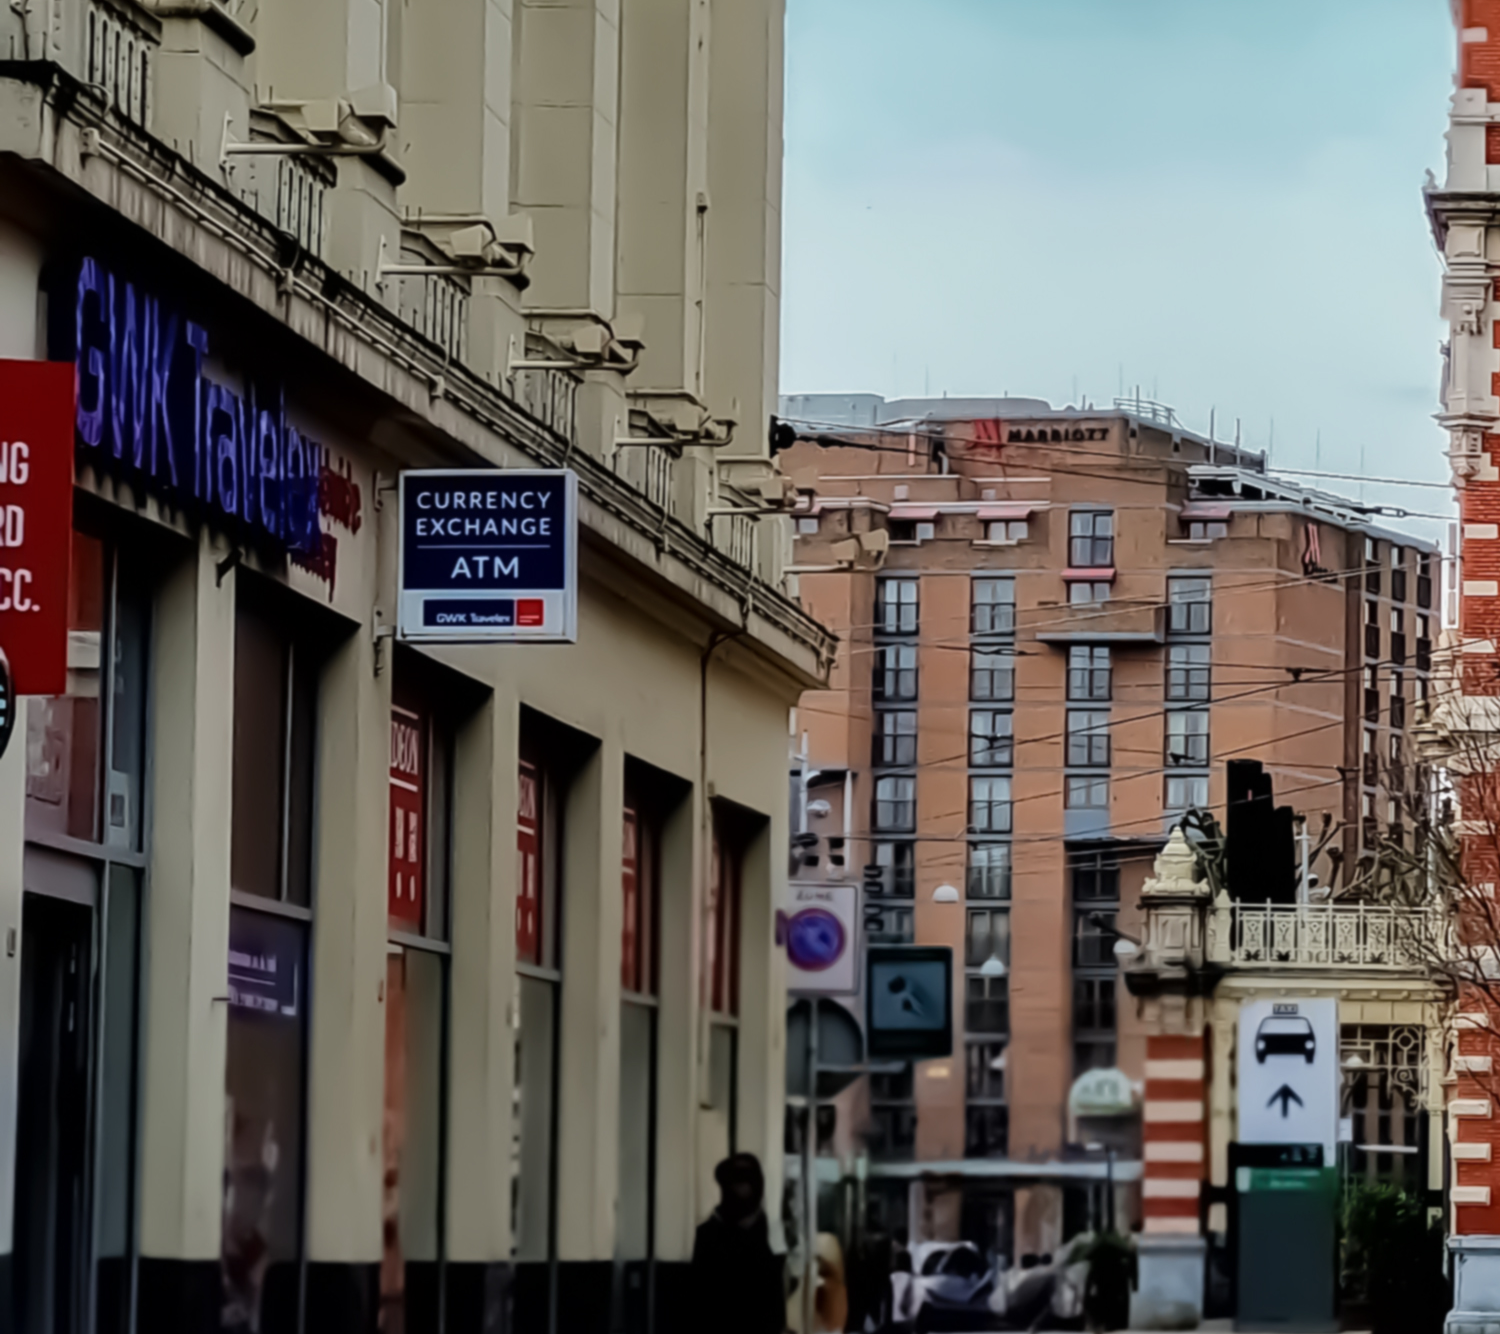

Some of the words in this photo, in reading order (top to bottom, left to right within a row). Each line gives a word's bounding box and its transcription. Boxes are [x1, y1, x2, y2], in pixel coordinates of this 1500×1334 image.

[76, 255, 178, 487] GWK
[1007, 427, 1110, 443] MARRIOTT
[416, 491, 552, 509] CURRENCY
[415, 517, 552, 536] EXCHANGE
[450, 555, 520, 579] ATM
[436, 613, 467, 623] GWK
[470, 612, 511, 623] Travelex
[1273, 1004, 1298, 1014] TAXI
